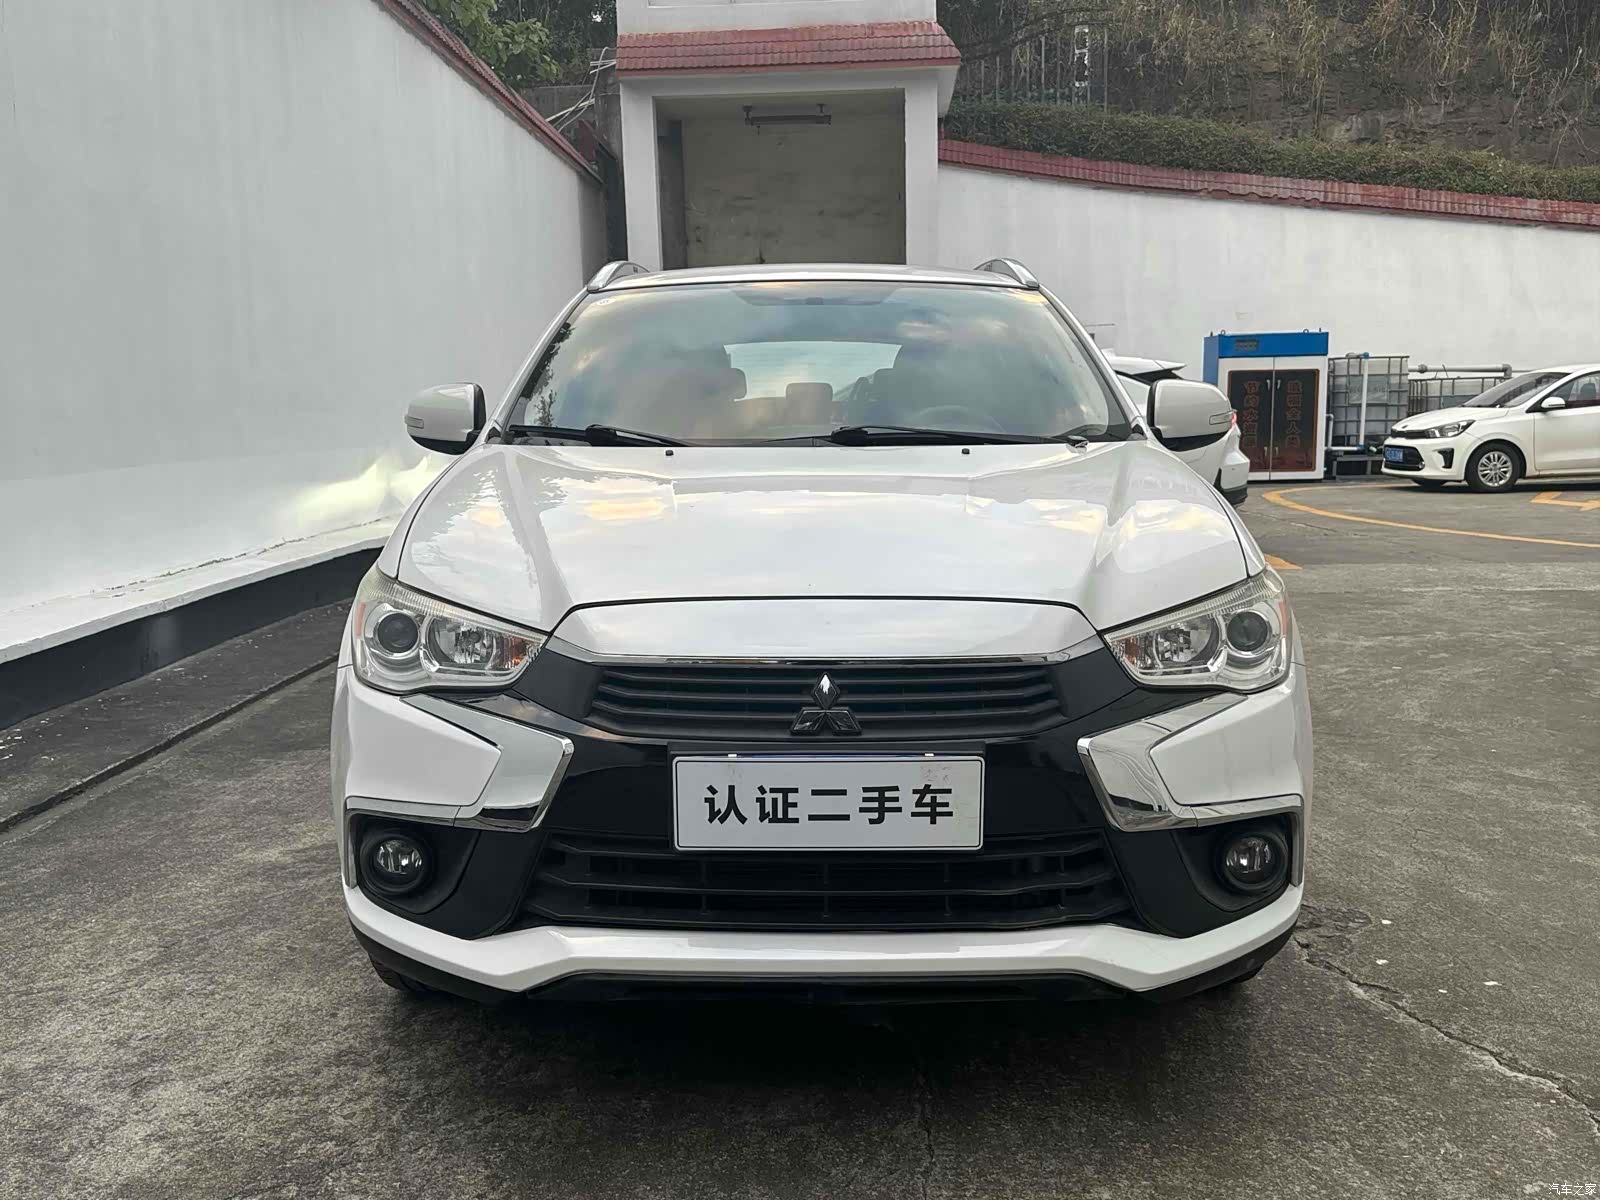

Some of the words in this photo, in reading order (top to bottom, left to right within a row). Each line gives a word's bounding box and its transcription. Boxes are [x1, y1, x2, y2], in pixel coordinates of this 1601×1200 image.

[703, 783, 955, 826] 认证二手车
